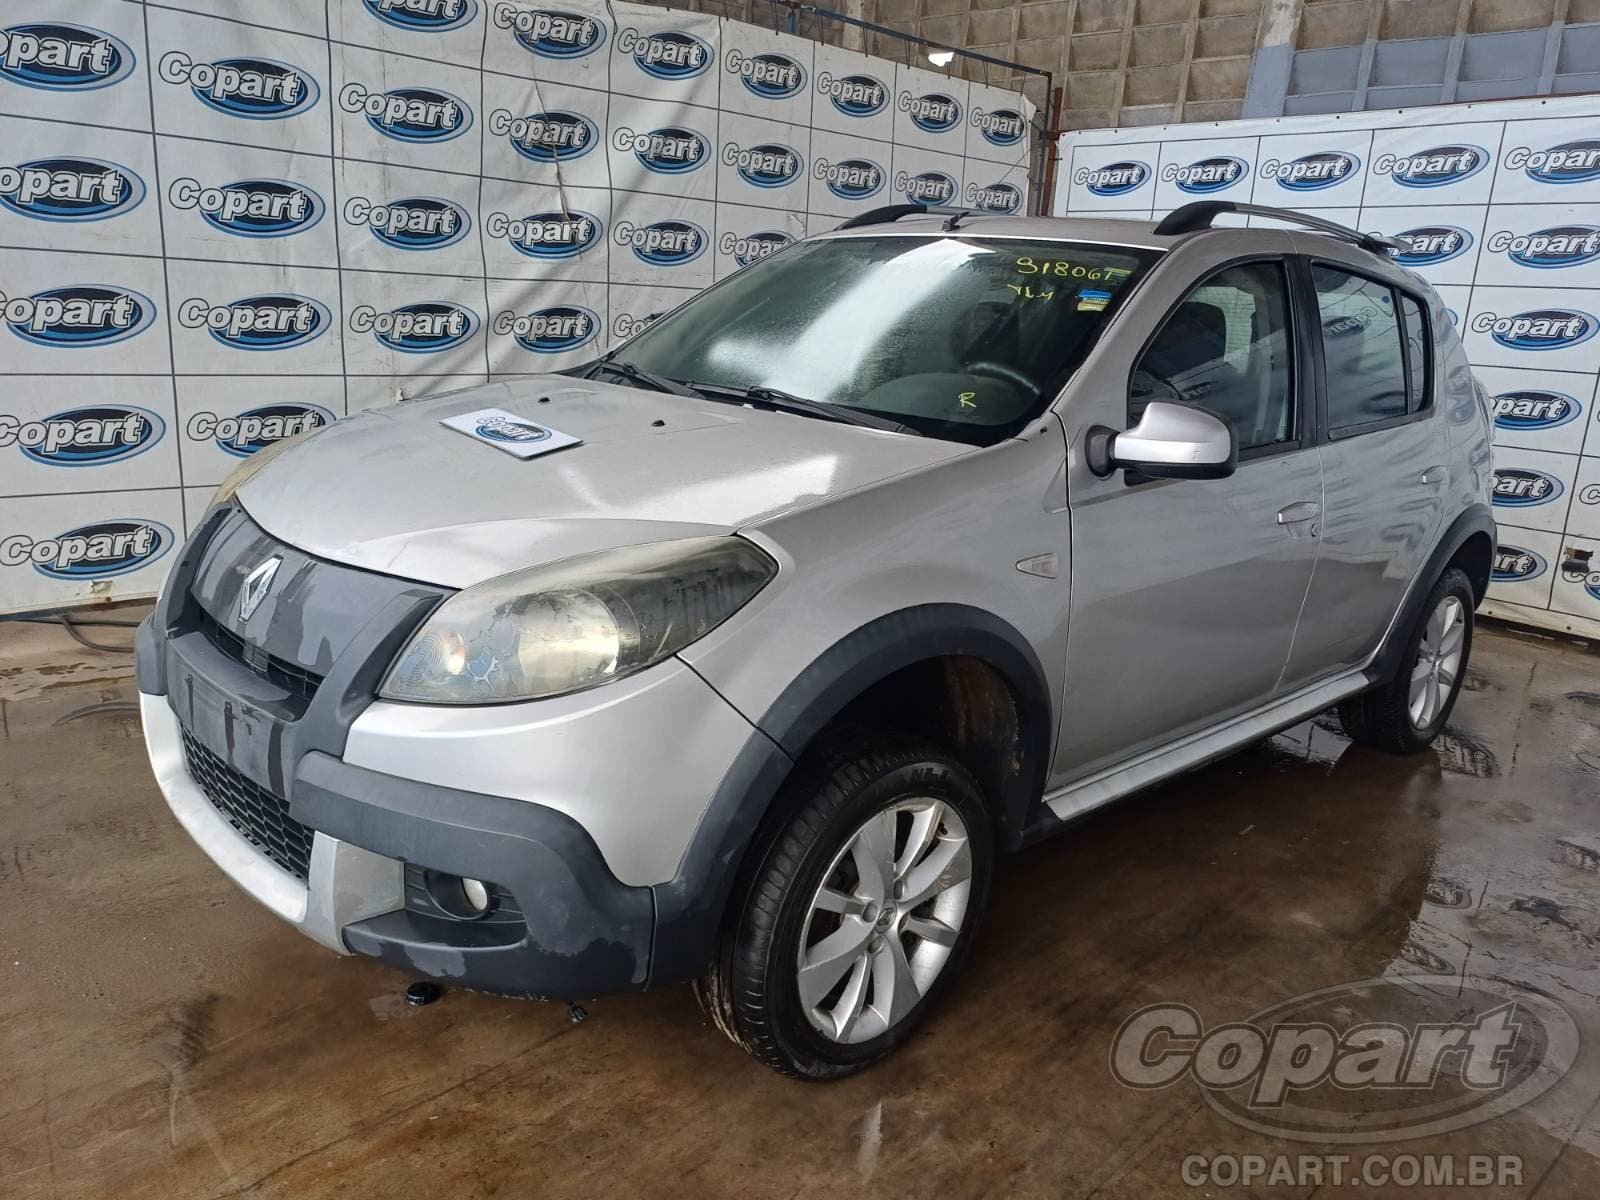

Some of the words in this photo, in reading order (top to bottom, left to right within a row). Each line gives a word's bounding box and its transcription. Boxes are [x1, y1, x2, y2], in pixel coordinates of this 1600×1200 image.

[493, 3, 596, 47] Copart
[618, 27, 702, 67] Copart
[158, 50, 304, 105] Copart
[725, 48, 799, 88] Copart
[338, 82, 459, 129] Copart
[817, 71, 882, 106] Copart
[898, 90, 957, 122] Copart
[970, 106, 1023, 137] Copart
[489, 108, 588, 149] Copart
[612, 126, 701, 161] Copart
[722, 142, 796, 176] Copart
[814, 157, 878, 189] Copart
[1161, 161, 1241, 184] Copart
[1260, 155, 1352, 183] Copart
[1373, 150, 1475, 179] Copart
[1504, 147, 1600, 174] Copar
[0, 166, 122, 204] opart
[895, 170, 951, 201] Copart
[1074, 164, 1144, 189] Copart
[168, 178, 309, 221] Copart
[965, 182, 1018, 209] Copart
[343, 196, 458, 236] Copart
[486, 211, 591, 248] Copart
[613, 221, 698, 254] Copart
[1487, 230, 1600, 259] Copart
[0, 293, 135, 333] opart
[178, 297, 313, 338] Copart
[350, 305, 464, 341] Copart
[494, 310, 590, 342] Copart
[1472, 311, 1584, 340] Copart
[958, 392, 977, 408] R
[1490, 397, 1566, 421] part
[0, 524, 153, 570] Copart
